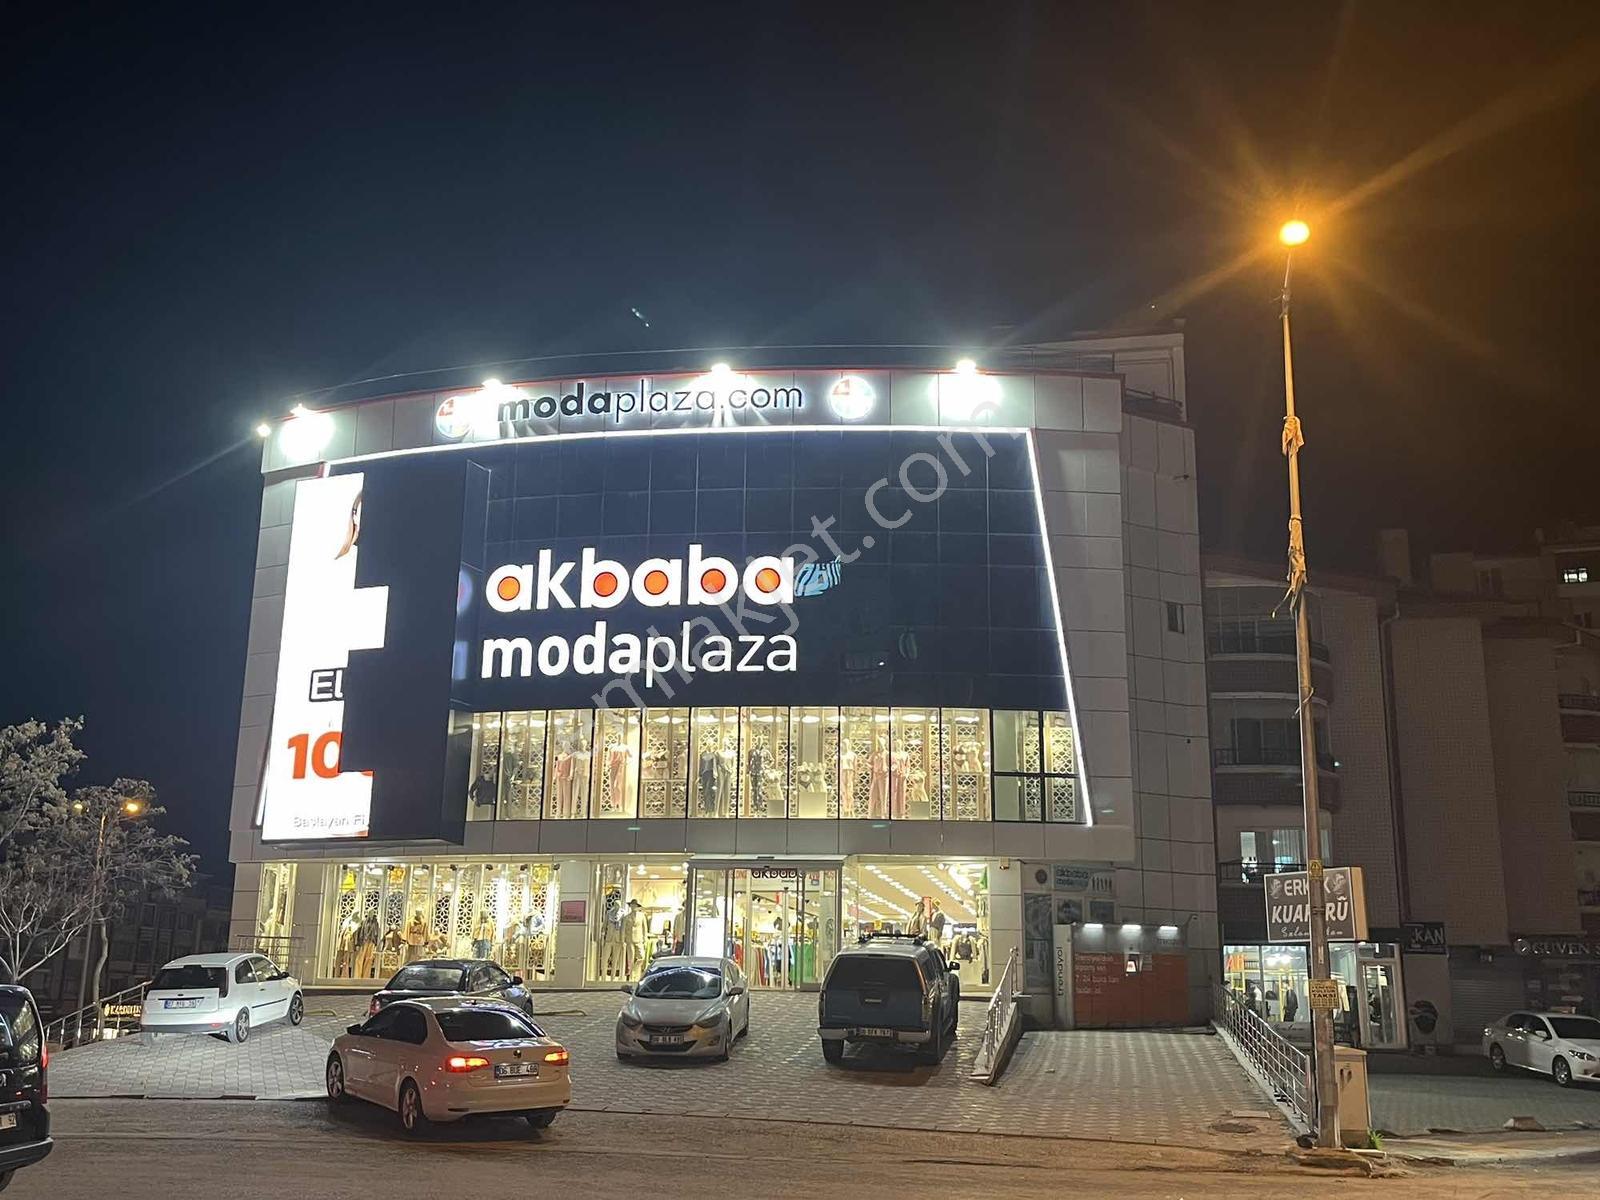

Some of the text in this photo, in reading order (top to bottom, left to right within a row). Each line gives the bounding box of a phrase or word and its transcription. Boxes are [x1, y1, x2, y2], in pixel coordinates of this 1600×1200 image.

[496, 378, 803, 424] modaplaza.com
[485, 543, 795, 613] akbaba
[481, 620, 798, 688] modaplaza
[1283, 876, 1331, 897] ERKK
[1410, 927, 1445, 946] KAN
